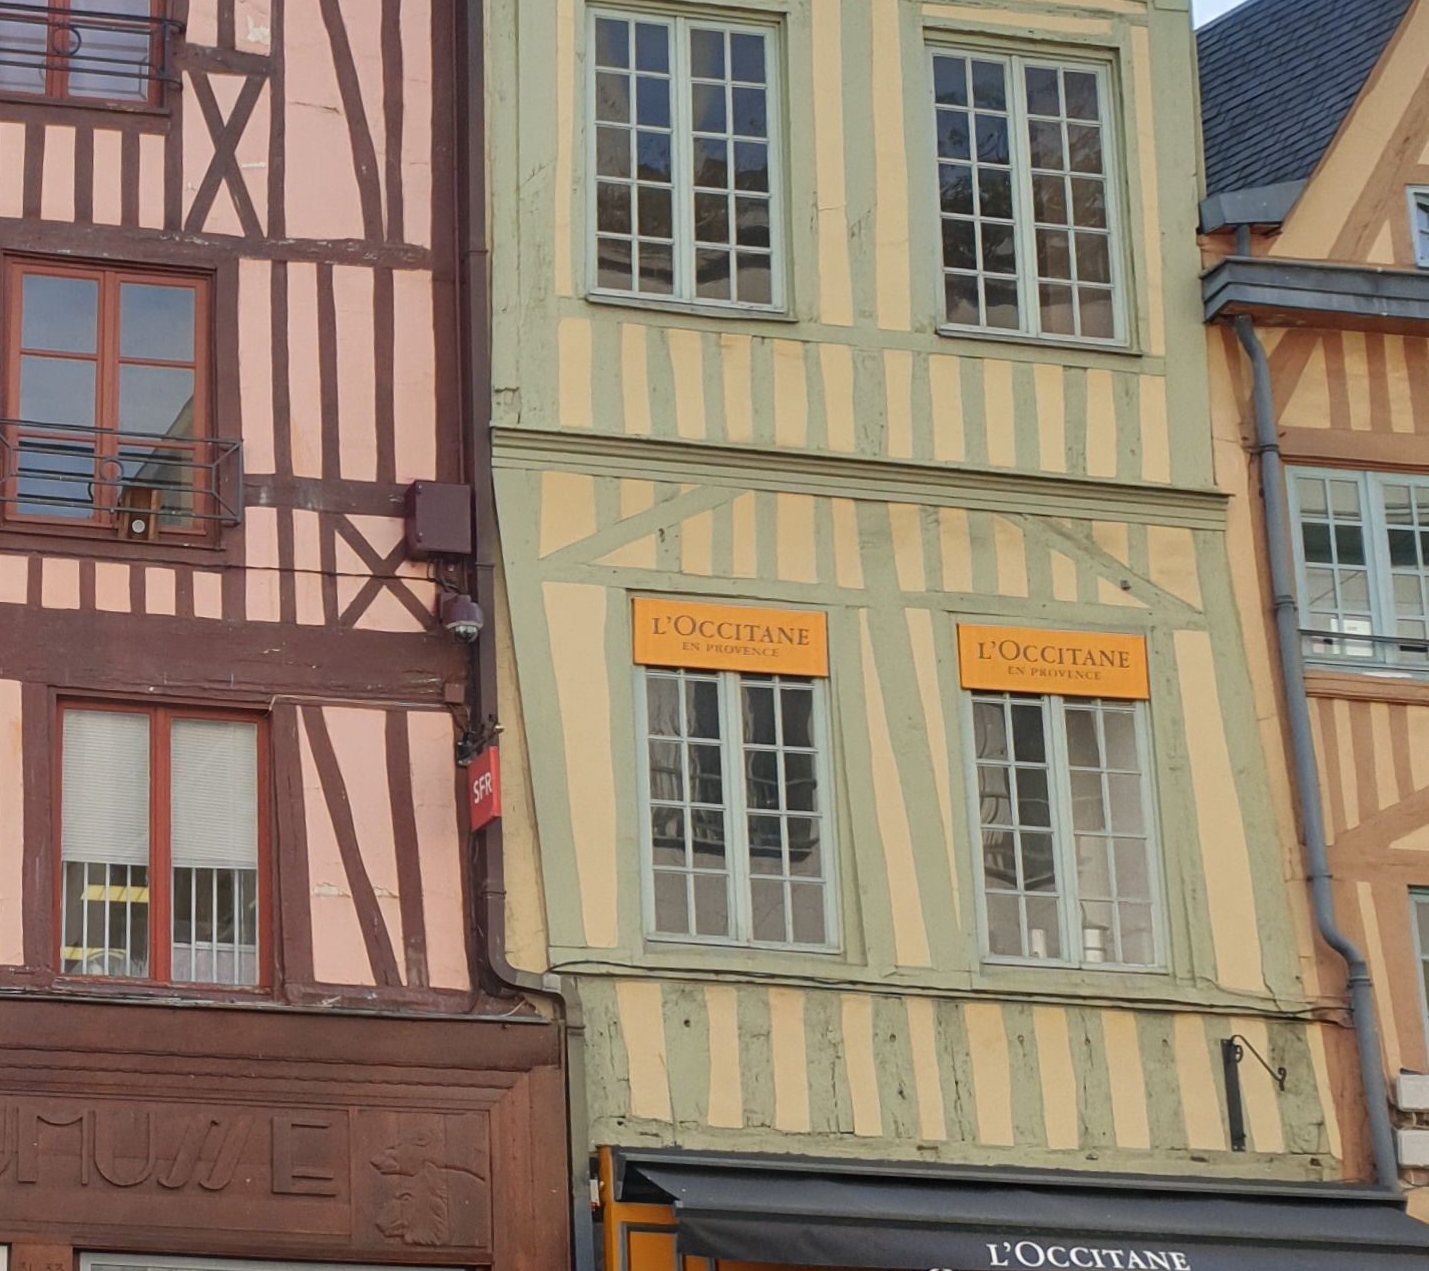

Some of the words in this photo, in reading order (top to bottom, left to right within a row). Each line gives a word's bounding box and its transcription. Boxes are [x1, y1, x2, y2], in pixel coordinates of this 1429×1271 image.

[682, 642, 700, 652] EN
[706, 644, 780, 658] PROVENCE
[1007, 666, 1025, 676] EN
[1031, 668, 1102, 681] PROVENCE
[473, 771, 493, 805] SFR
[986, 1241, 1191, 1271] L'OCCITANE
